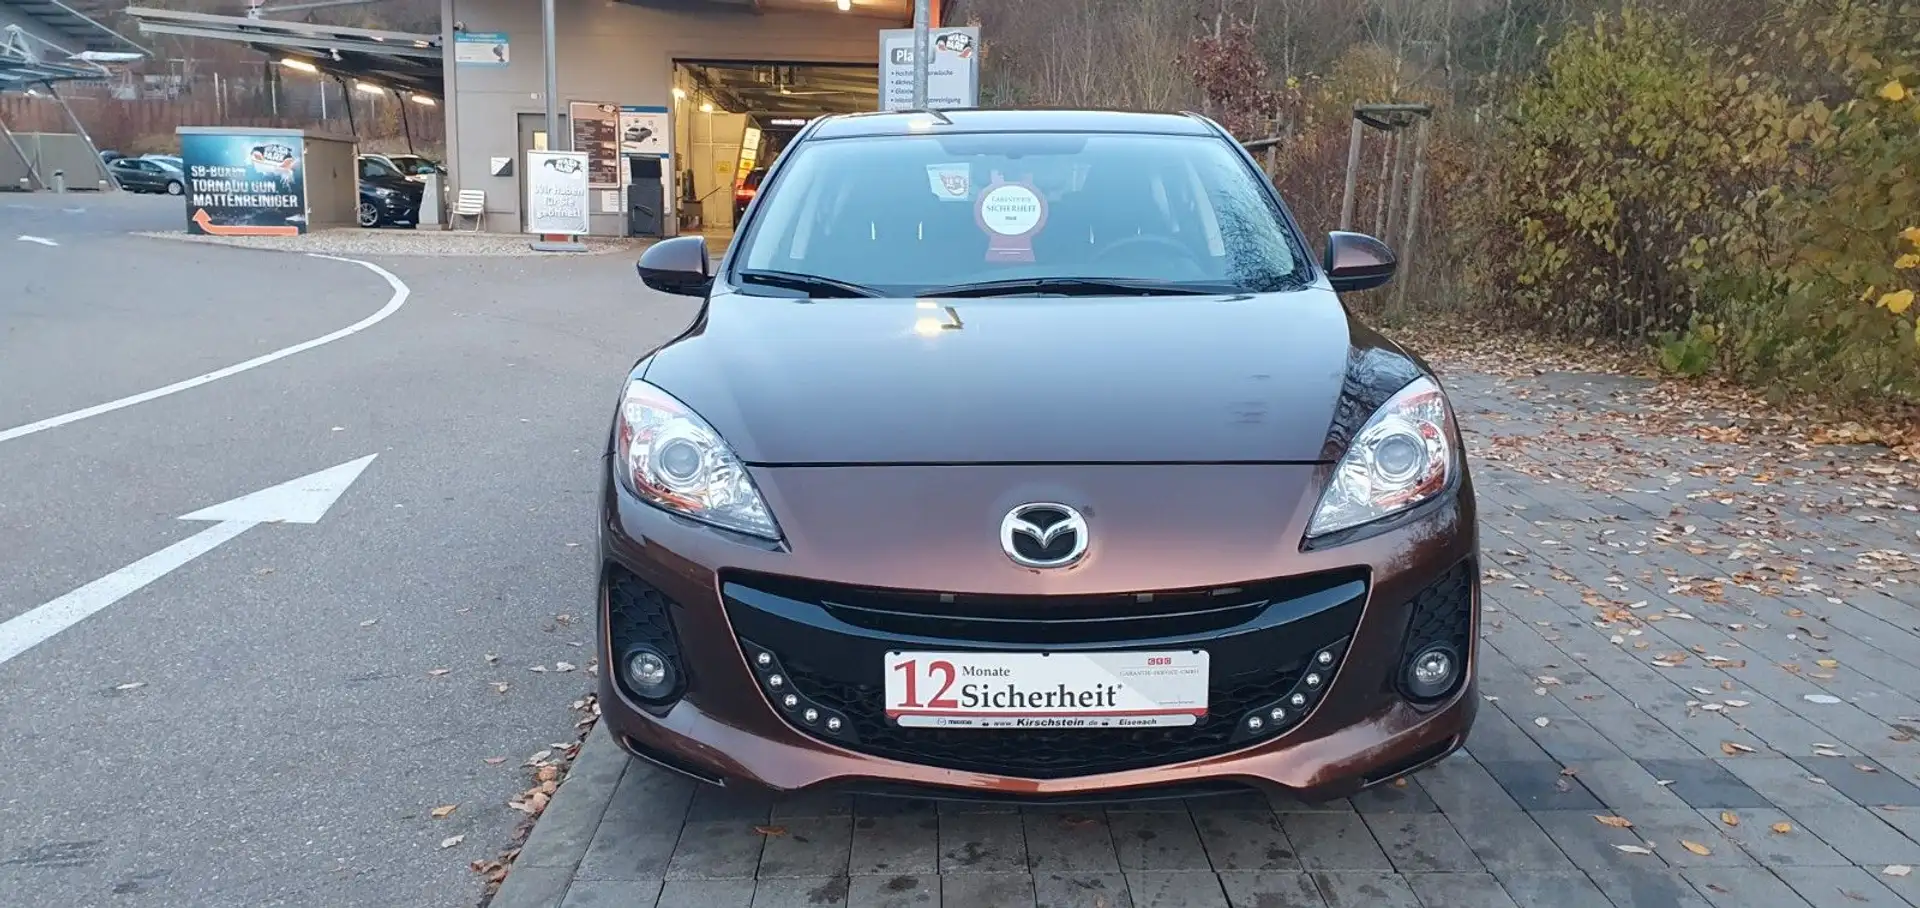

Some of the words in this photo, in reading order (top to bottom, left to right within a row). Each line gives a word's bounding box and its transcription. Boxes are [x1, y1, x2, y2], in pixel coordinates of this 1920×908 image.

[192, 178, 249, 192] TORNADO
[193, 193, 298, 208] MATTENREINIGER
[894, 659, 958, 708] 12
[962, 665, 1011, 677] Monate
[1016, 717, 1085, 727] Kirschstein
[1118, 718, 1157, 726] Eisenach
